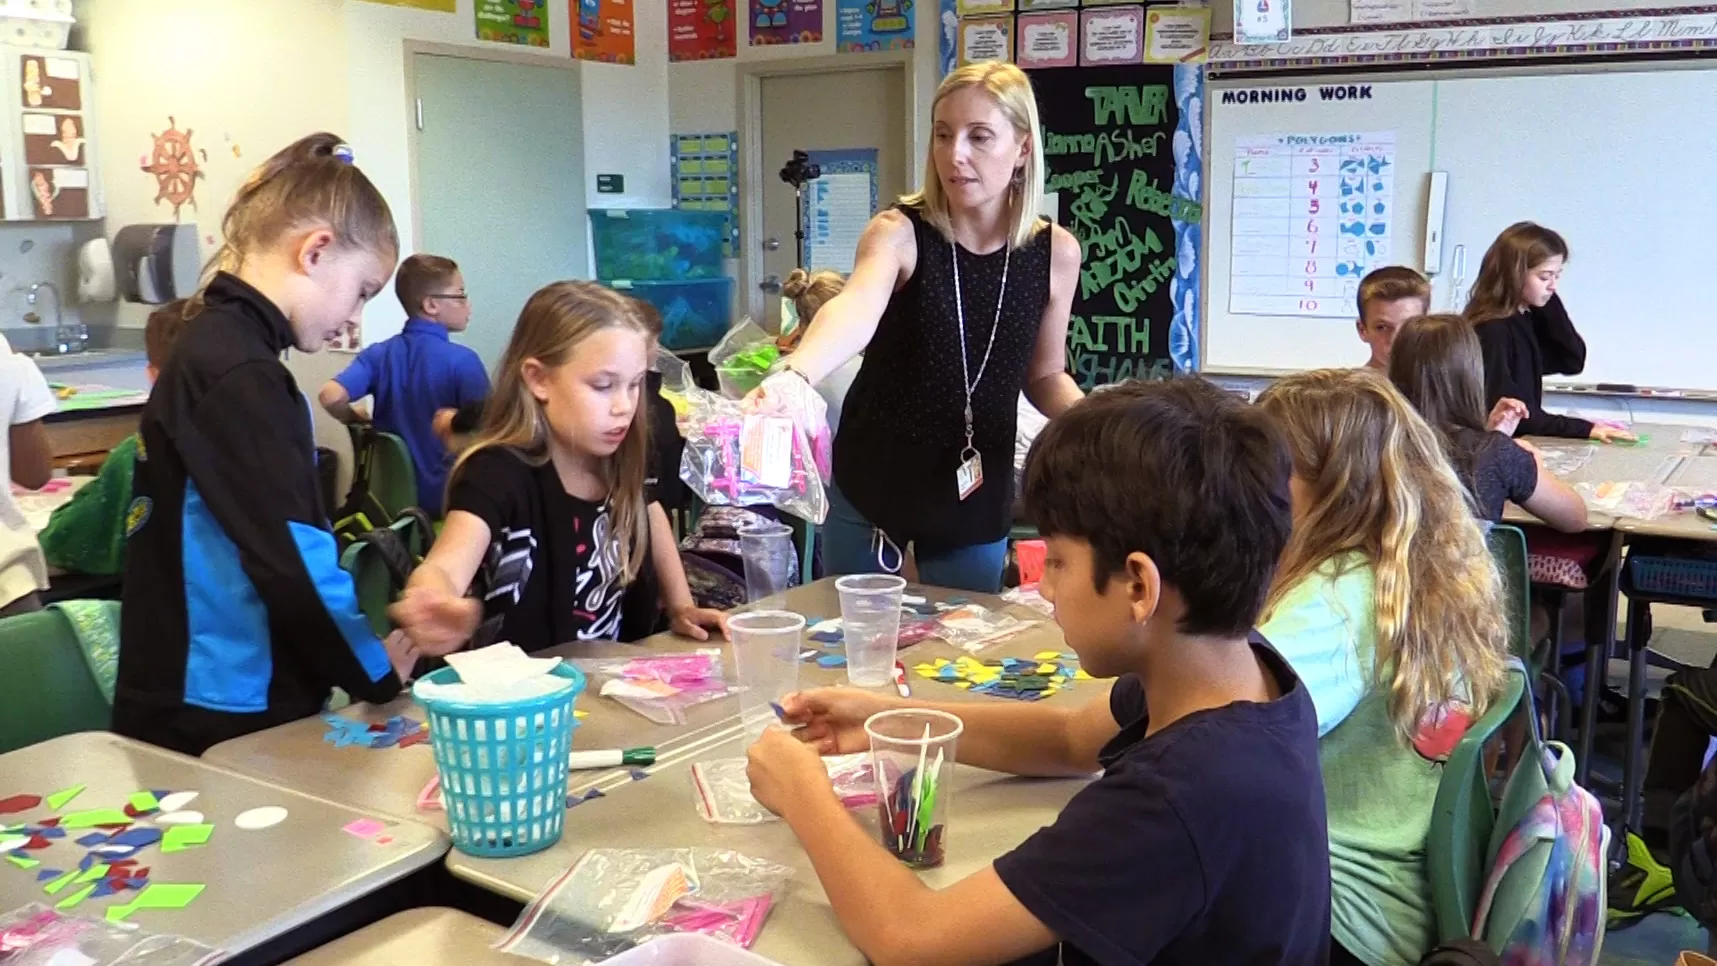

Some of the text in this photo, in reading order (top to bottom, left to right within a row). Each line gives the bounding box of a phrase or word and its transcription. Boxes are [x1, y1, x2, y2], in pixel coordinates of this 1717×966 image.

[1222, 85, 1372, 104] MORNING WORK
[1287, 134, 1354, 145] POLYGONS
[1308, 158, 1320, 173] 3
[1308, 180, 1318, 195] 4
[1308, 199, 1320, 214] 5
[1306, 219, 1319, 233] 6
[1305, 240, 1317, 254] 7
[1305, 260, 1317, 275] 8
[1304, 280, 1314, 292] 9
[1299, 300, 1318, 311] 10
